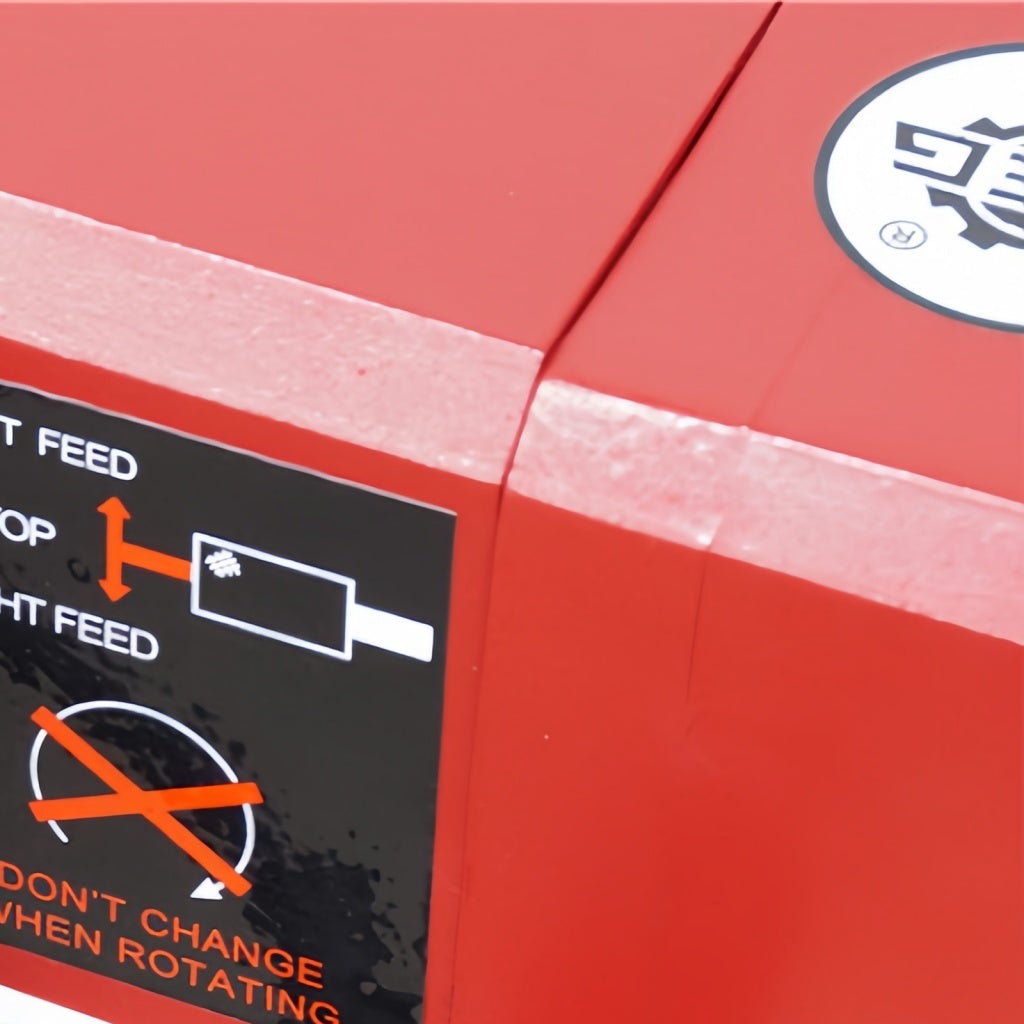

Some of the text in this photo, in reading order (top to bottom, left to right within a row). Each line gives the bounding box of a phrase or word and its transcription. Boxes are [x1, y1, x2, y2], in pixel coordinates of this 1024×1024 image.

[38, 427, 138, 481] FEED
[54, 605, 160, 661] FEED
[140, 908, 324, 989] CHANGE
